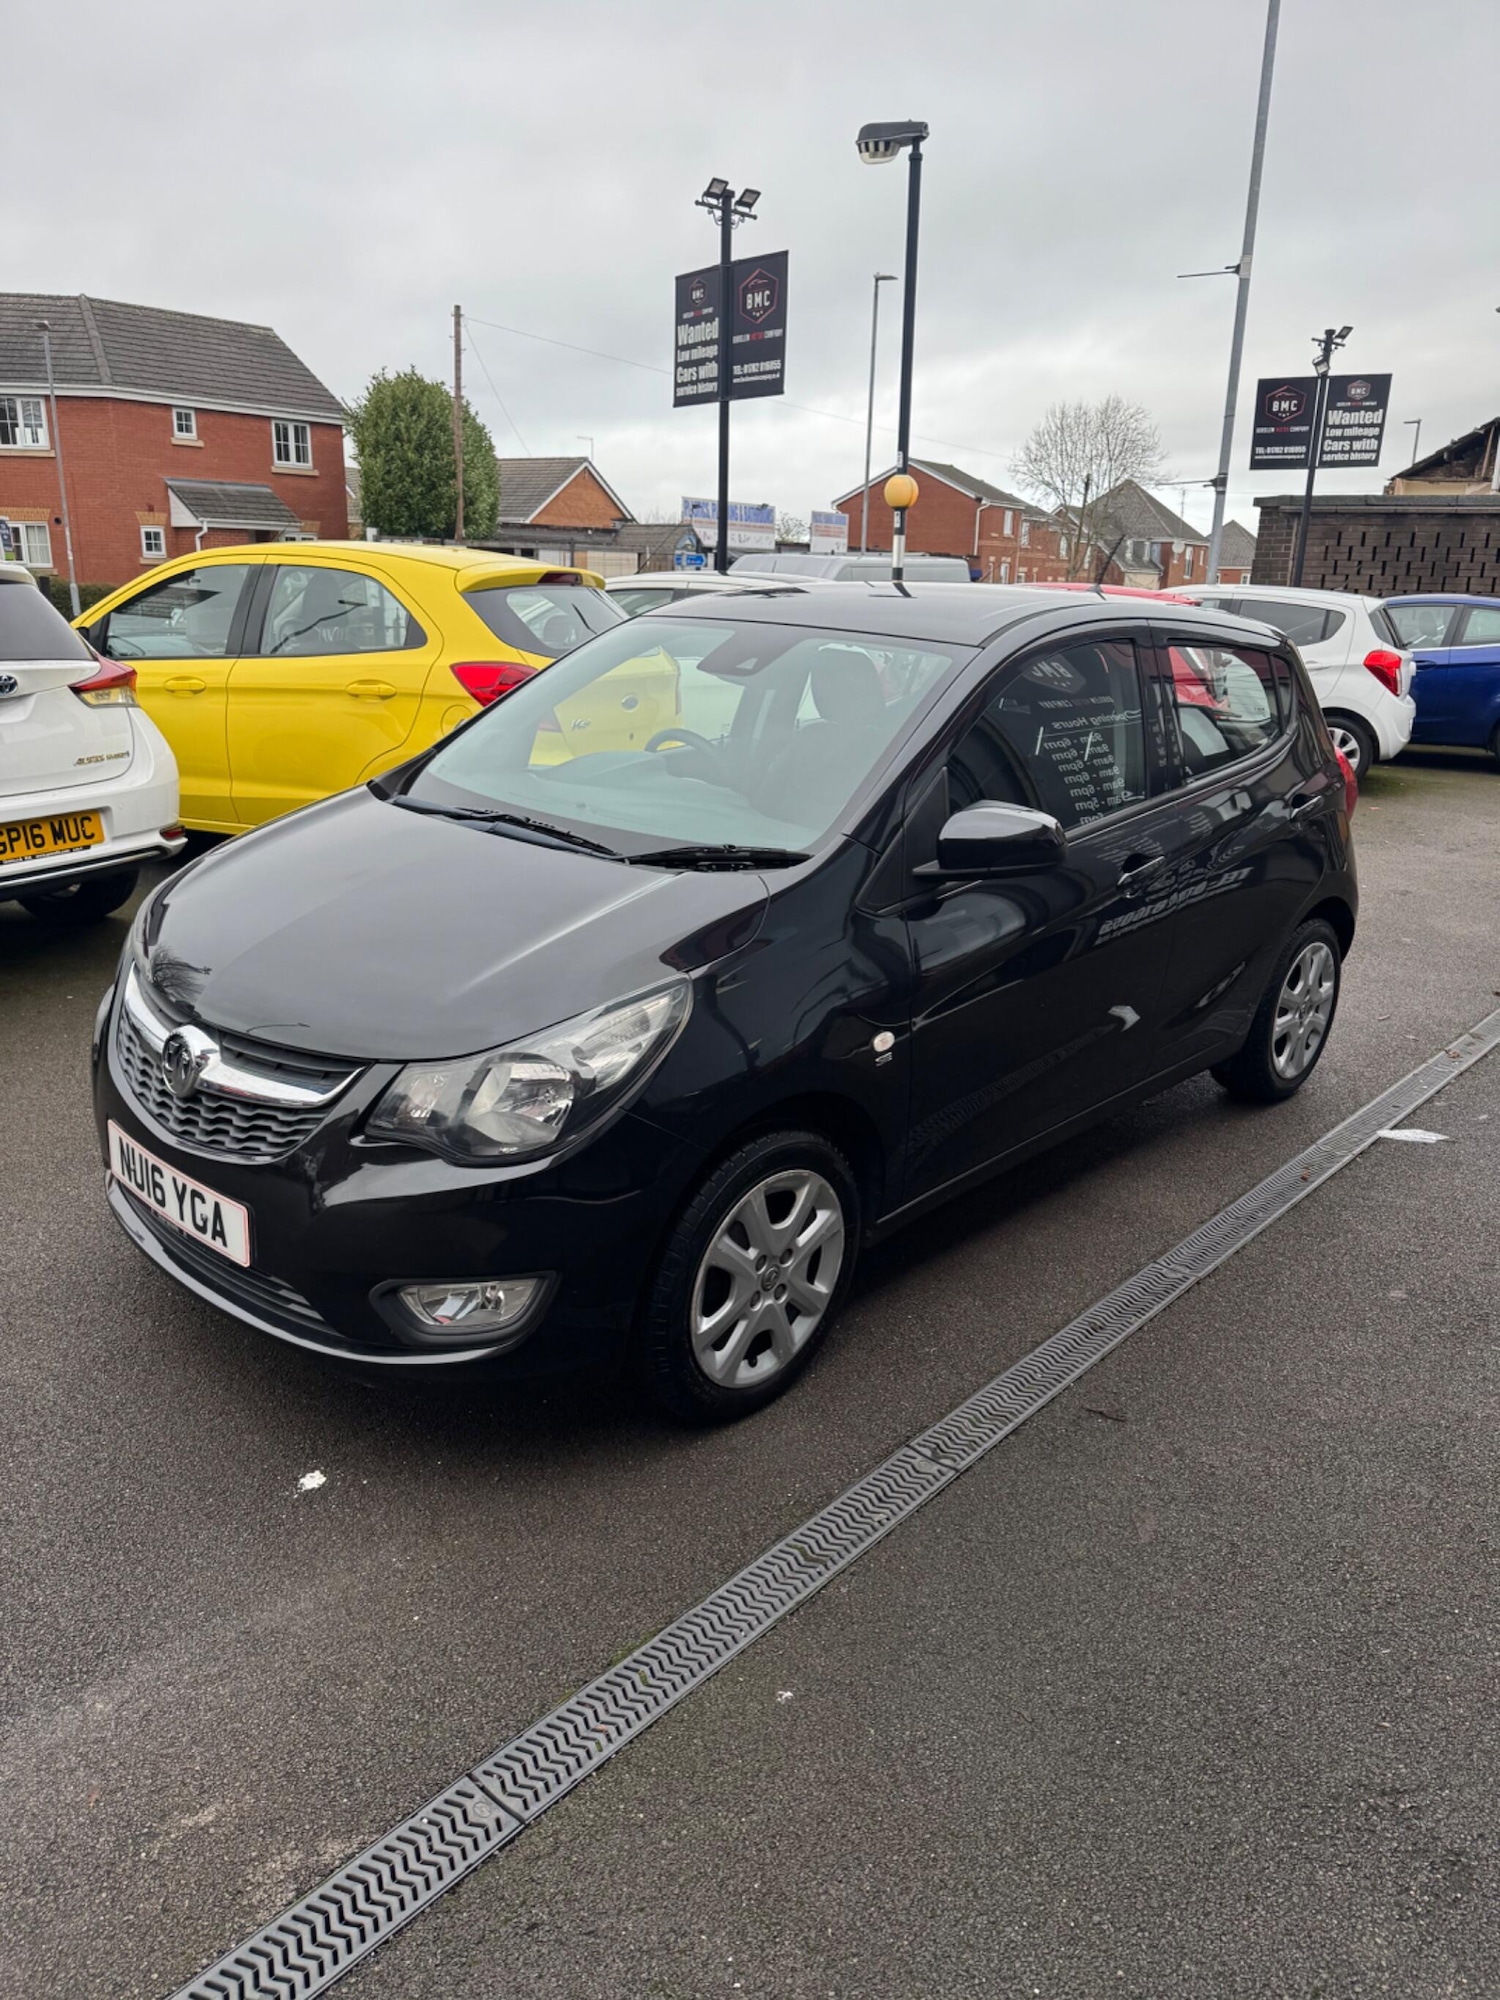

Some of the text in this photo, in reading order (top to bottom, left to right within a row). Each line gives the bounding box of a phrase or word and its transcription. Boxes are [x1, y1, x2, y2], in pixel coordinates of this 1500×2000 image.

[746, 290, 771, 310] BMC
[677, 317, 719, 346] Wanted
[677, 344, 719, 362] Low mileage
[676, 366, 697, 383] Cars
[698, 360, 719, 379] with
[676, 381, 718, 397] service history
[1272, 400, 1298, 412] BMC
[1328, 409, 1384, 426] Wanted
[1326, 426, 1380, 437] Low mileage
[1323, 438, 1378, 452] Cars with
[1322, 452, 1377, 462] service history
[50, 815, 95, 846] MUC
[118, 1136, 228, 1248] NU16 YGA
